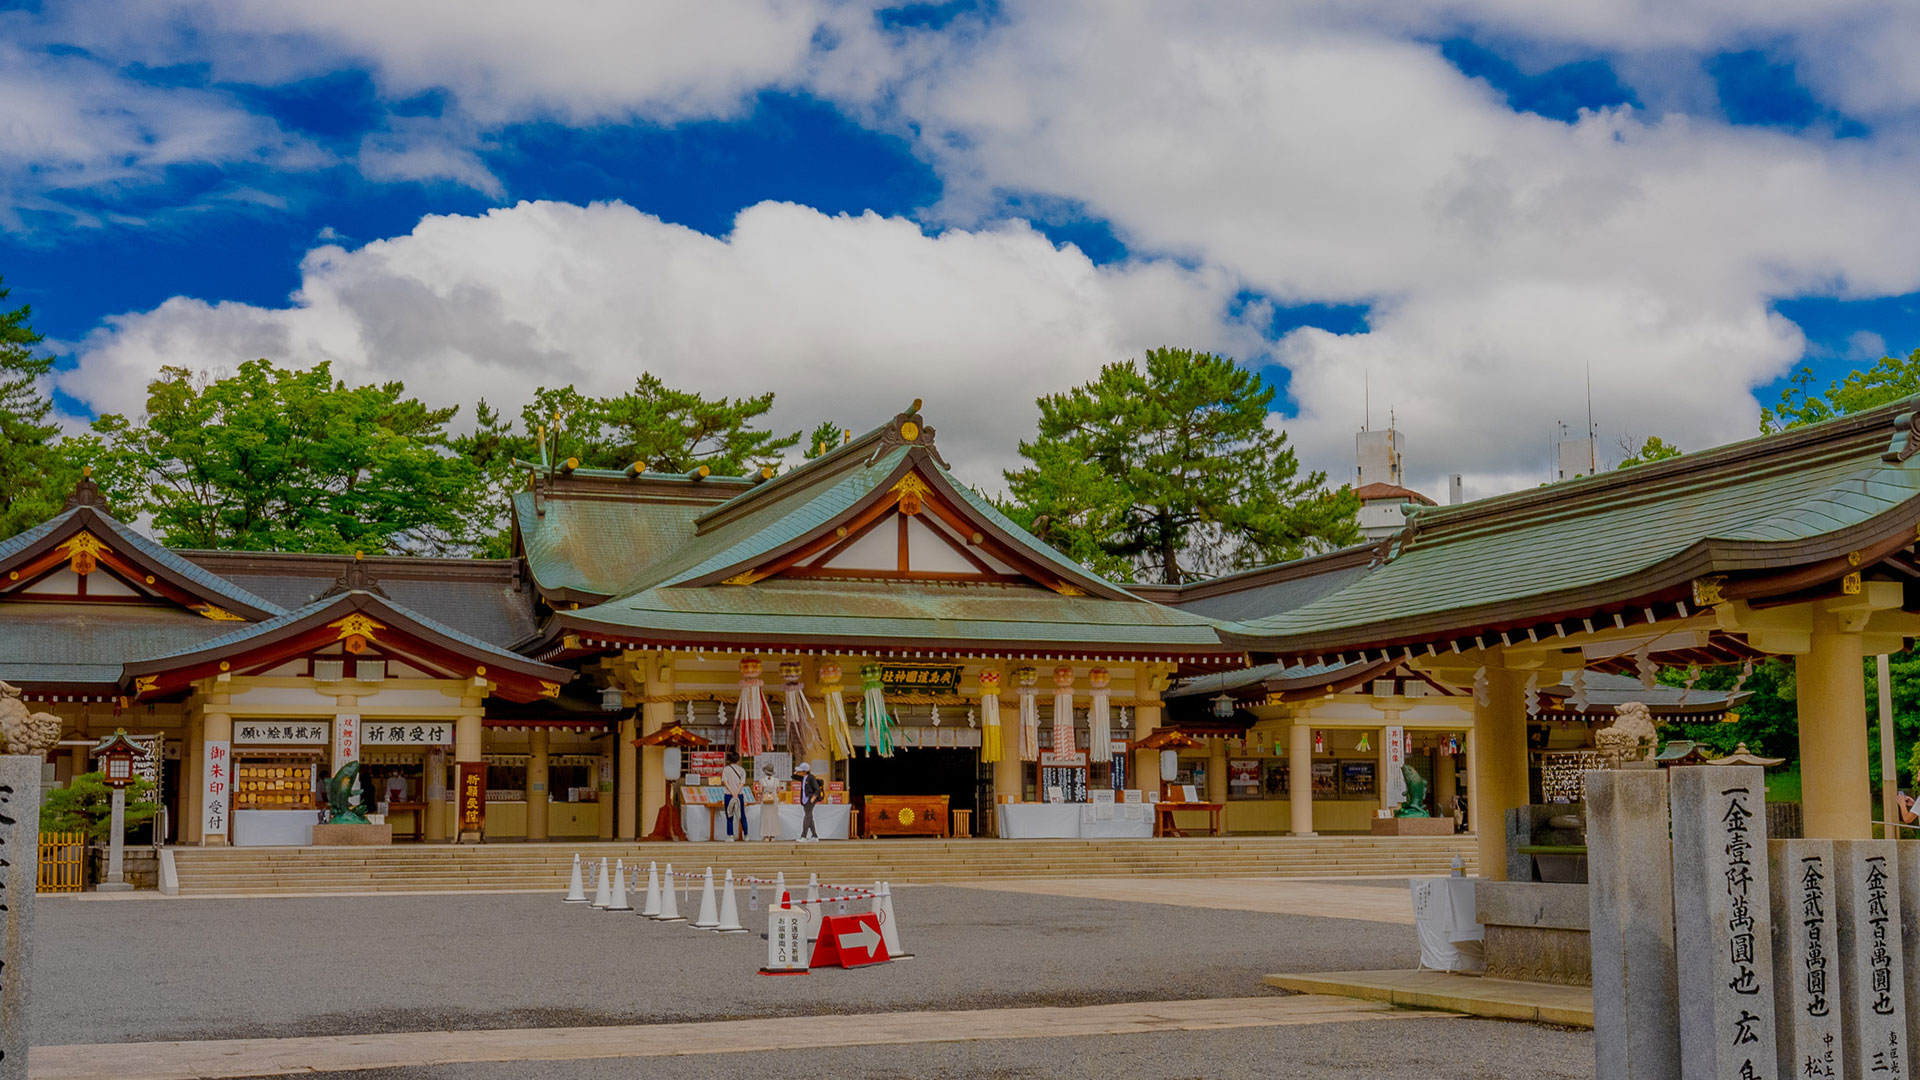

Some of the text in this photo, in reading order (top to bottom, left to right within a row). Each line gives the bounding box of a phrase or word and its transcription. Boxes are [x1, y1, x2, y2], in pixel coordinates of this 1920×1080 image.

[368, 725, 445, 742] 祈願受付
[208, 746, 225, 830] 御朱印受付
[465, 774, 481, 823] 祈願受付
[1822, 1032, 1835, 1080] 中区上
[1888, 1031, 1901, 1080] 東区光
